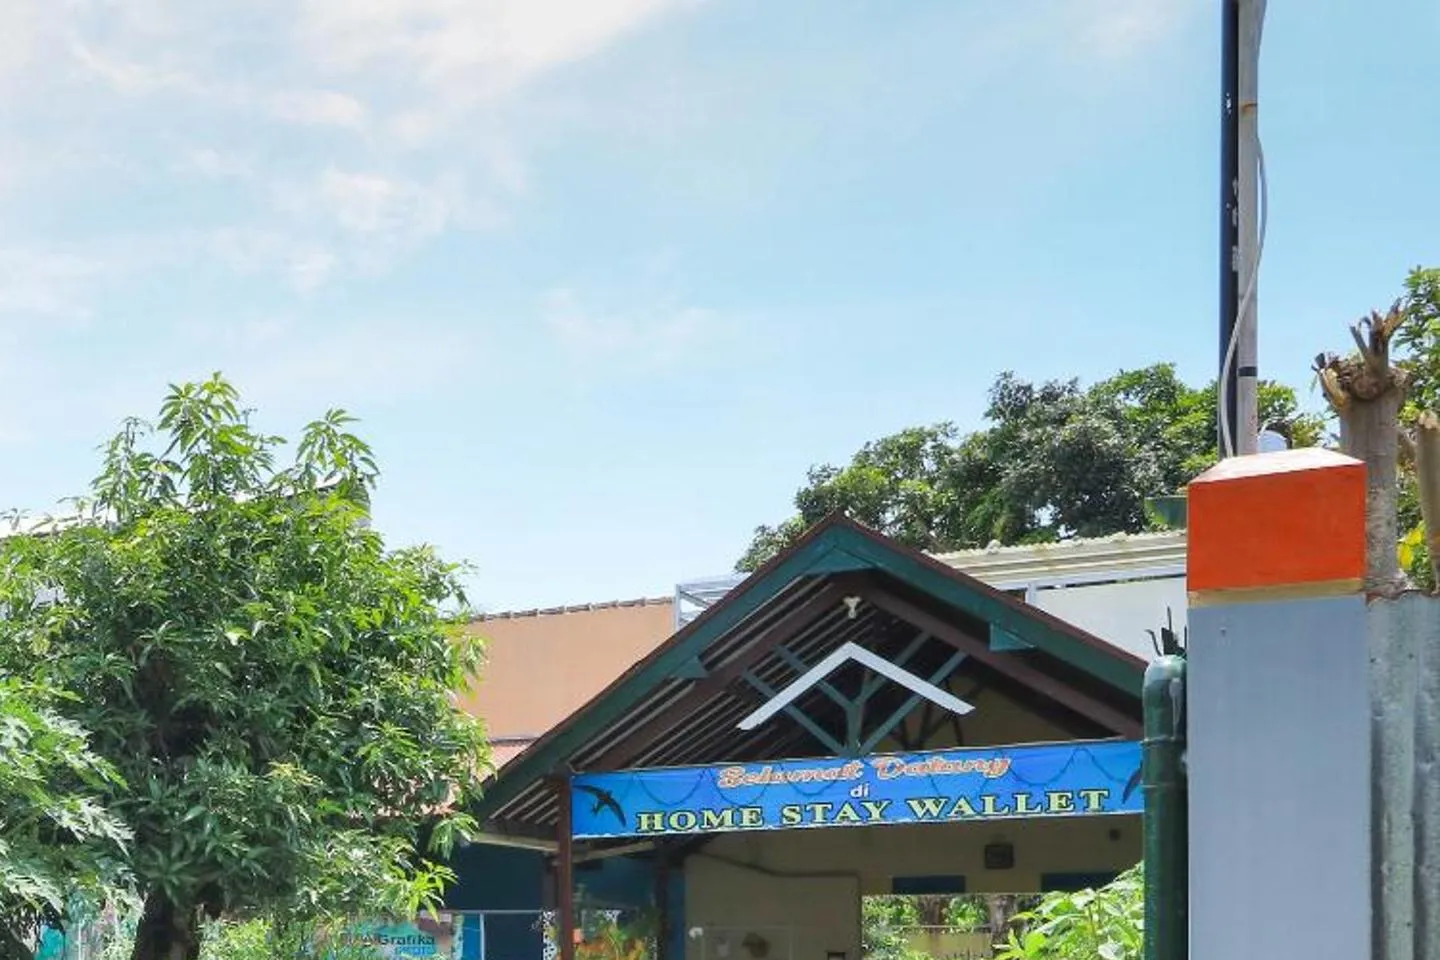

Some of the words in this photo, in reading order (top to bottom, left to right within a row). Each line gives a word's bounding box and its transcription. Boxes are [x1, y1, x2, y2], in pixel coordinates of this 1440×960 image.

[718, 759, 864, 788] Selamat
[871, 756, 1011, 779] Datang
[850, 783, 870, 798] di
[636, 805, 764, 833] HOME
[781, 800, 893, 826] STAY
[907, 789, 1109, 820] WALLET
[379, 934, 435, 946] Grafika
